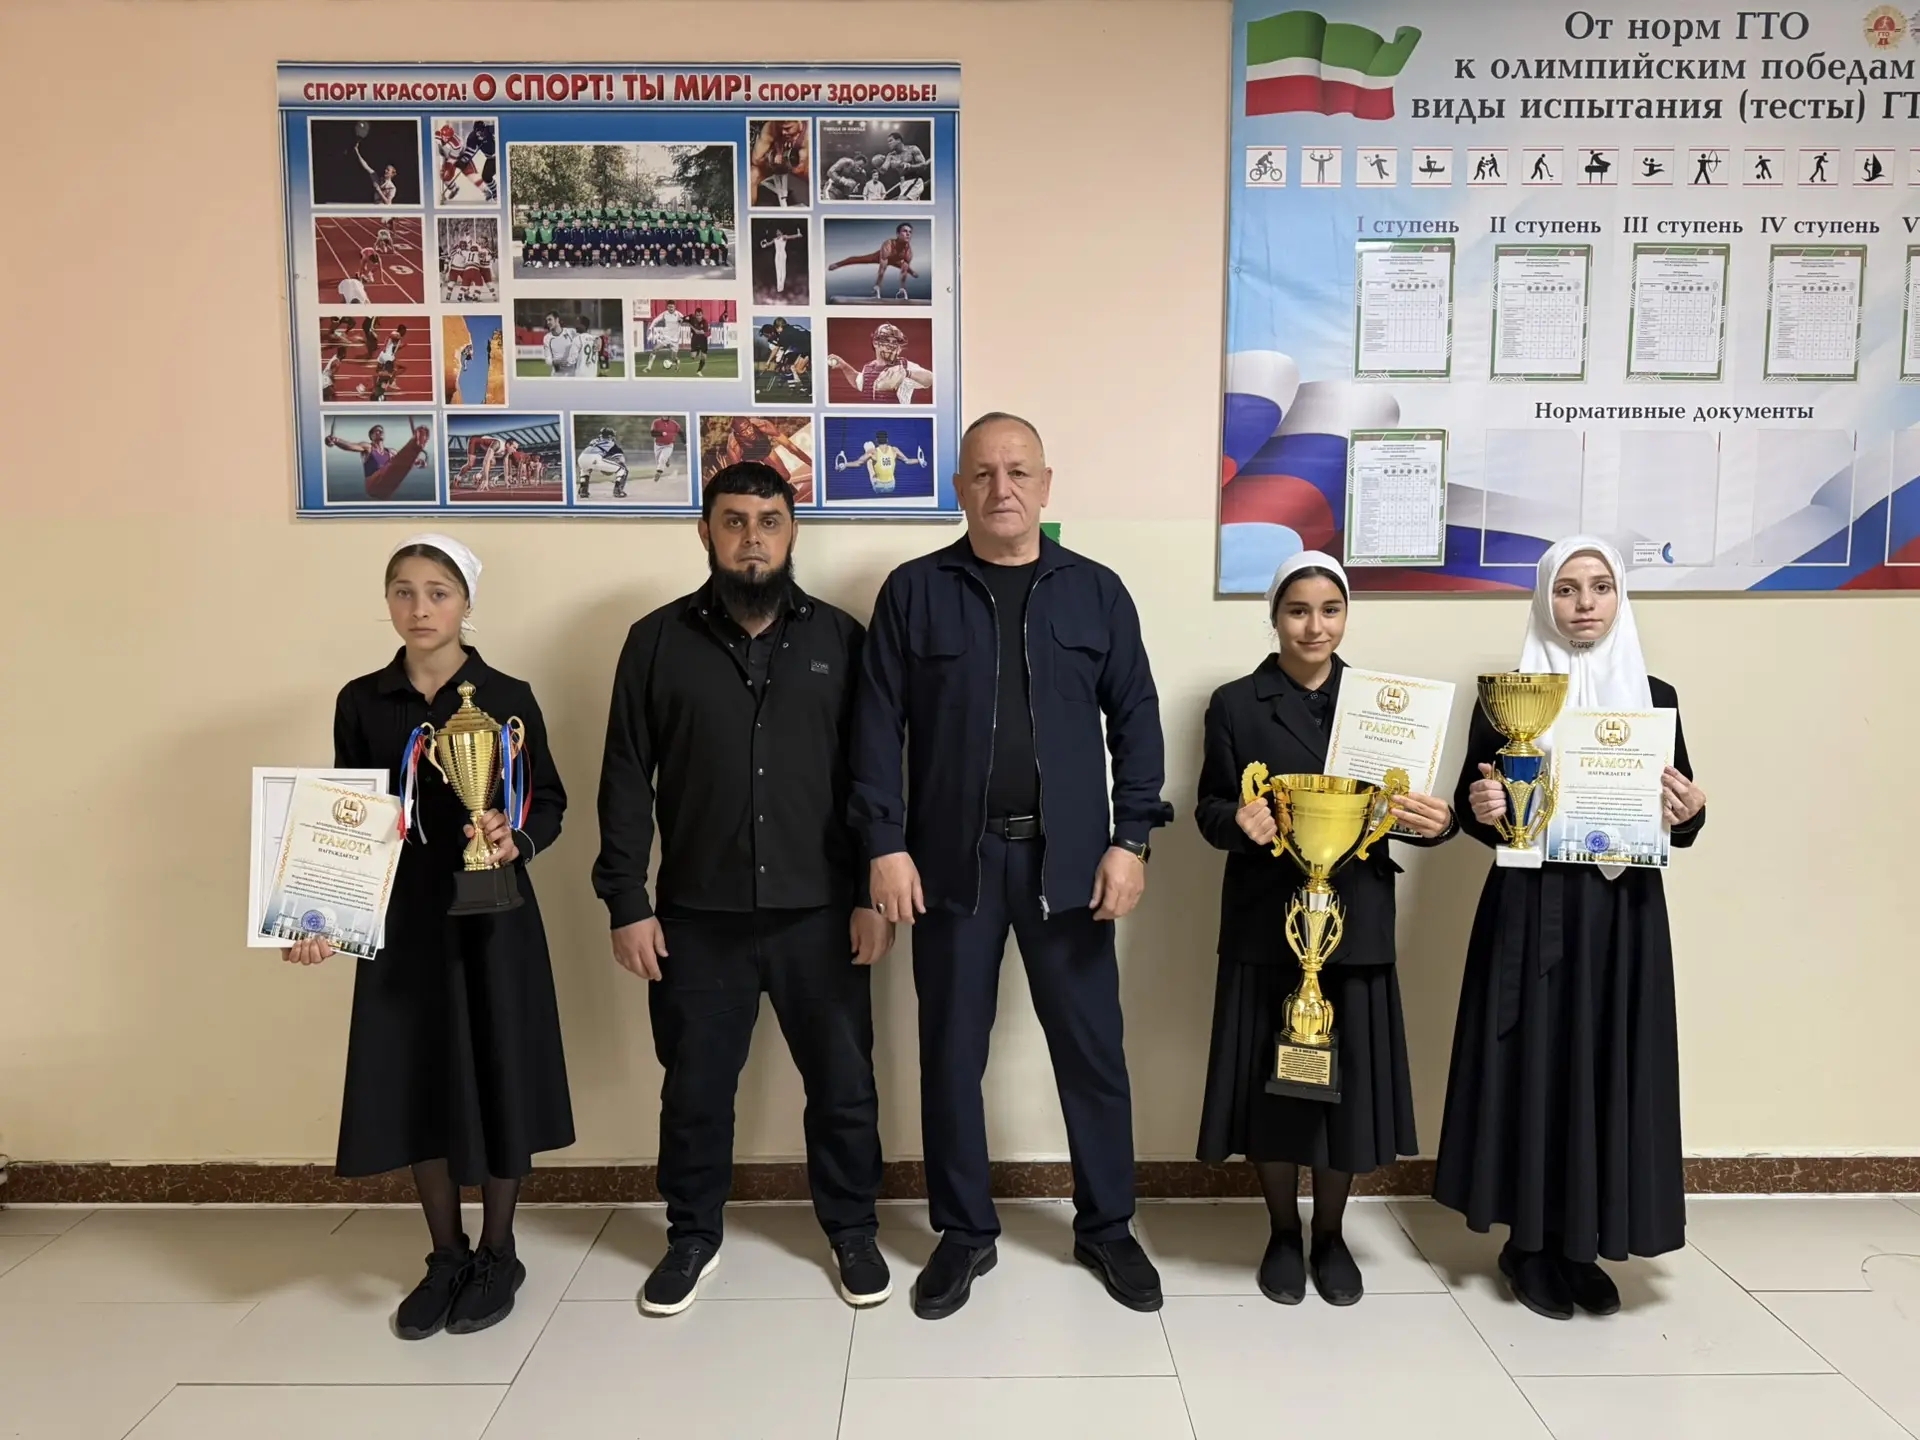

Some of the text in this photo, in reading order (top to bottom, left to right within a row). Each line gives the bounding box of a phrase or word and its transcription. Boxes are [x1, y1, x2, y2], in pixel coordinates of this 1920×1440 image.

[1565, 11, 1810, 47] От норм ГТО
[1454, 51, 1915, 85] к олимпийским победам
[303, 82, 467, 101] СПОРТ КРАСОТА!
[473, 73, 752, 101] О СПОРТ! ТЫ МИР!
[758, 83, 937, 104] СПОРТ ЗДОРОВЬЕ!
[1411, 98, 1506, 124] виды
[1520, 98, 1723, 119] испытания
[1739, 88, 1866, 124] (тесты)
[1356, 215, 1460, 237] I ступень
[1489, 216, 1601, 237] II ступень
[1623, 216, 1743, 237] III ступень
[1760, 216, 1880, 238] IV ступень
[1535, 402, 1814, 423] Нормативные документы
[1359, 719, 1416, 740] ГРАМОТА
[1579, 757, 1644, 769] ГРАМОТА
[312, 831, 372, 856] ГРАМОТА
